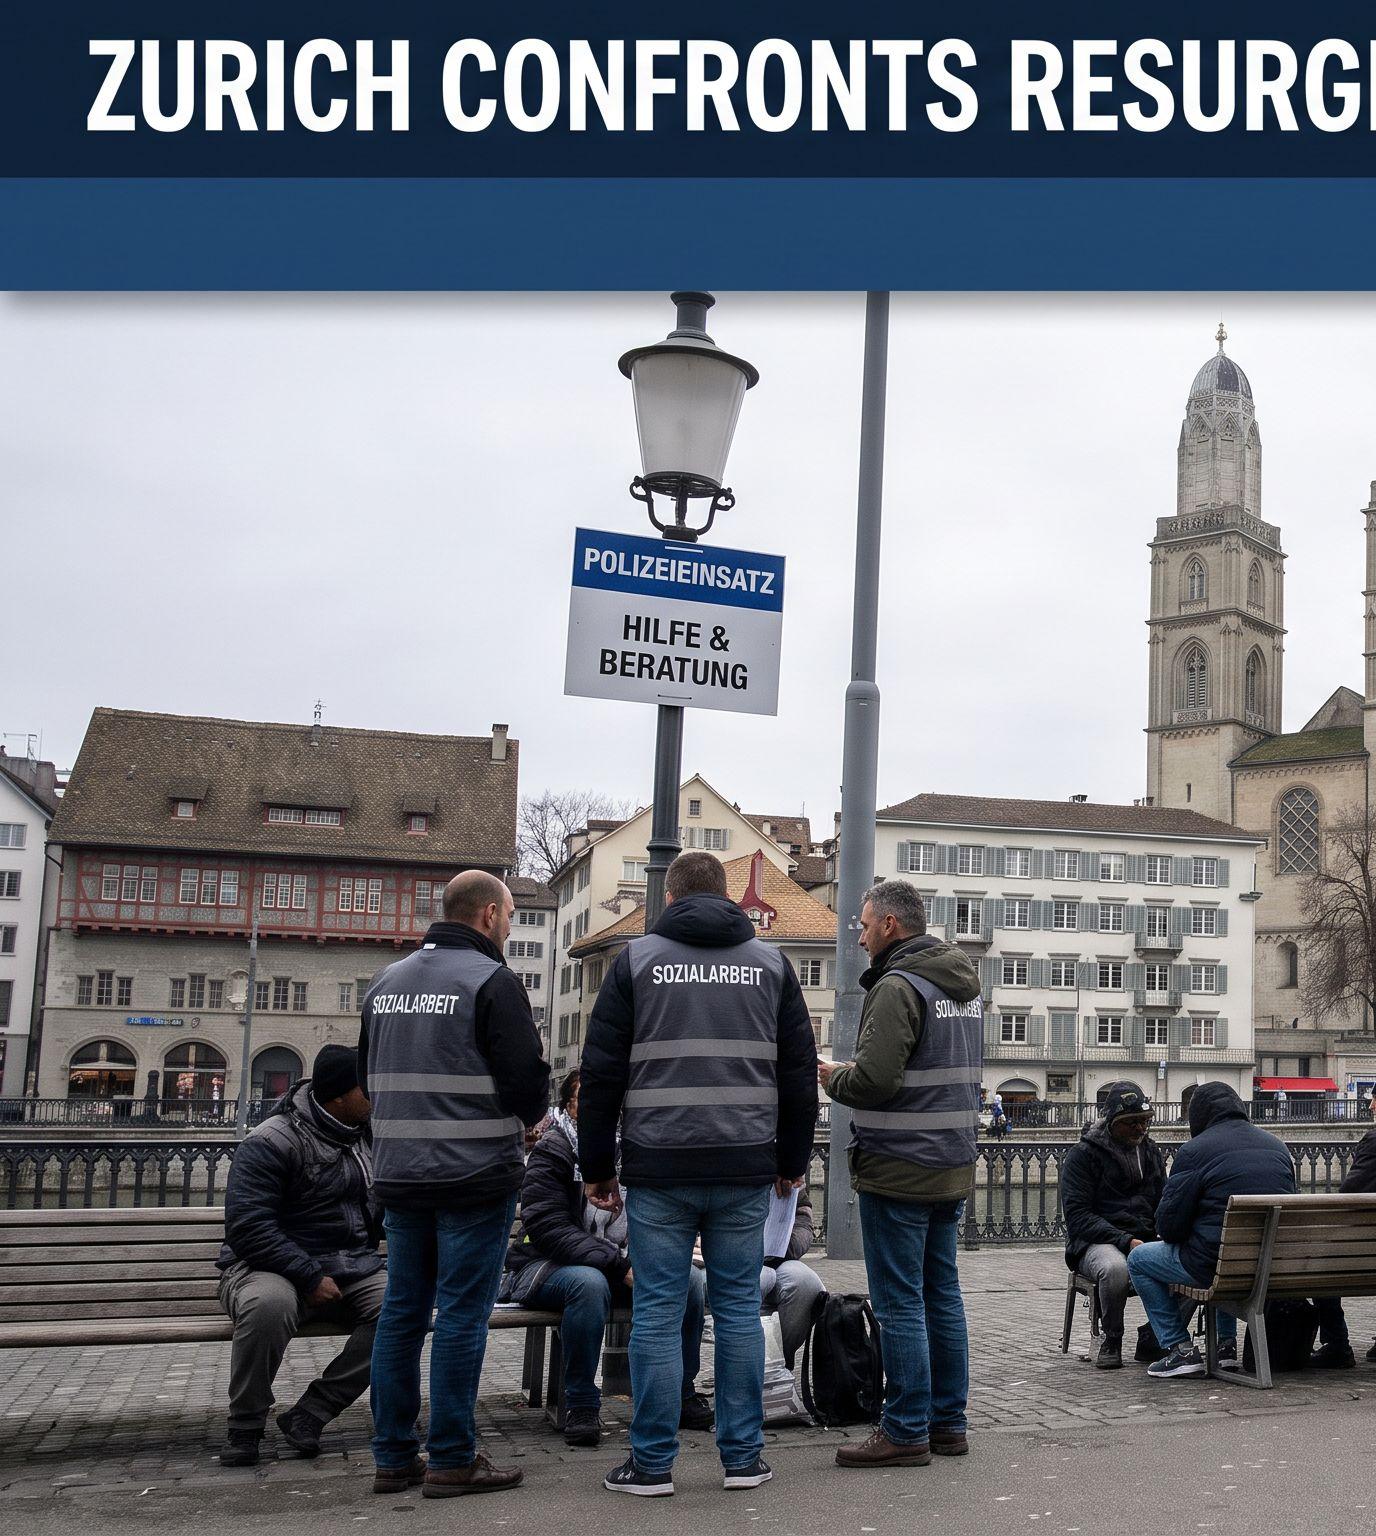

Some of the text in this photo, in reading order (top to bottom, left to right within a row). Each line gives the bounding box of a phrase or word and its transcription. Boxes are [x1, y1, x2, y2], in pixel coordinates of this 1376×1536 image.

[583, 547, 775, 595] POLIZEIEINSATZ
[622, 614, 730, 652] HILFE &
[599, 648, 748, 690] BERATUNG
[652, 963, 764, 986] SOZIALARBEIT
[372, 993, 460, 1015] SOZIALARBEIT
